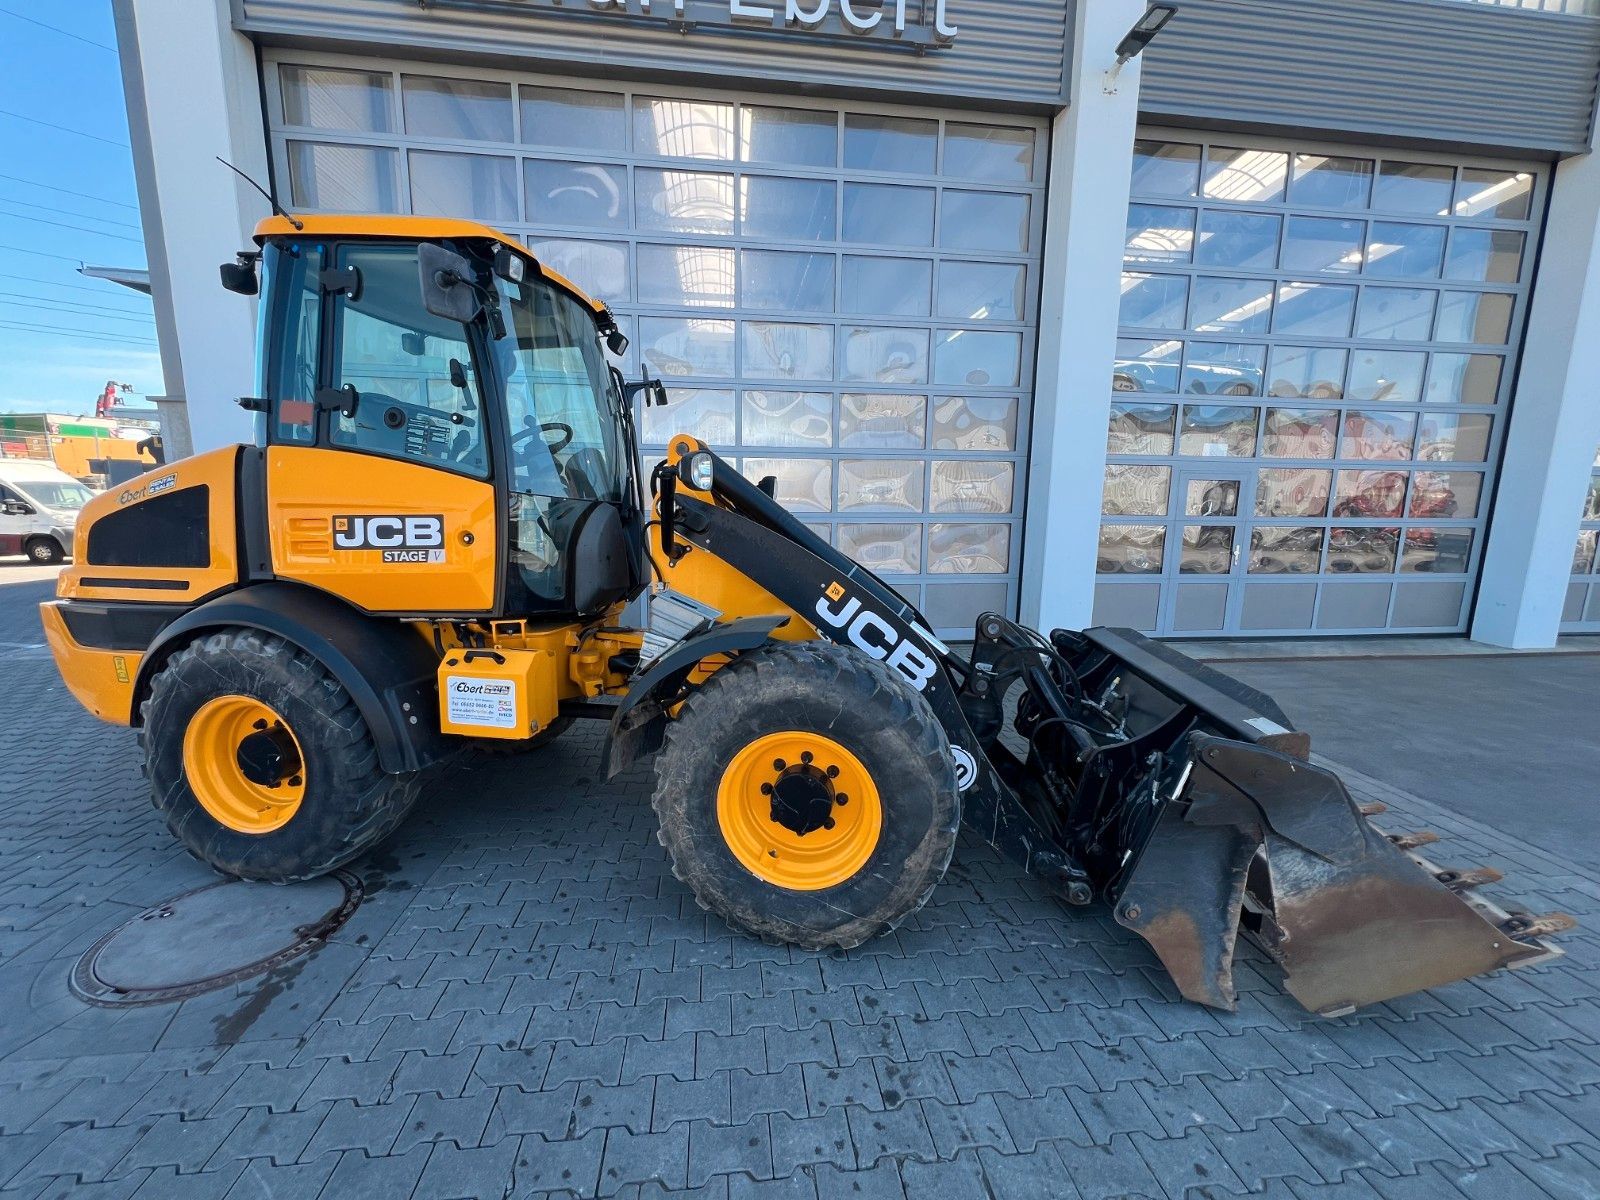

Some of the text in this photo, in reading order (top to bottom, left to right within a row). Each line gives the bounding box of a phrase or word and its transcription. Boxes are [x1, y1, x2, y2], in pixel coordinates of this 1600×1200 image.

[335, 517, 442, 547] JCB
[384, 550, 442, 562] STAGE V
[815, 596, 937, 692] JCB
[456, 681, 484, 694] Ebert
